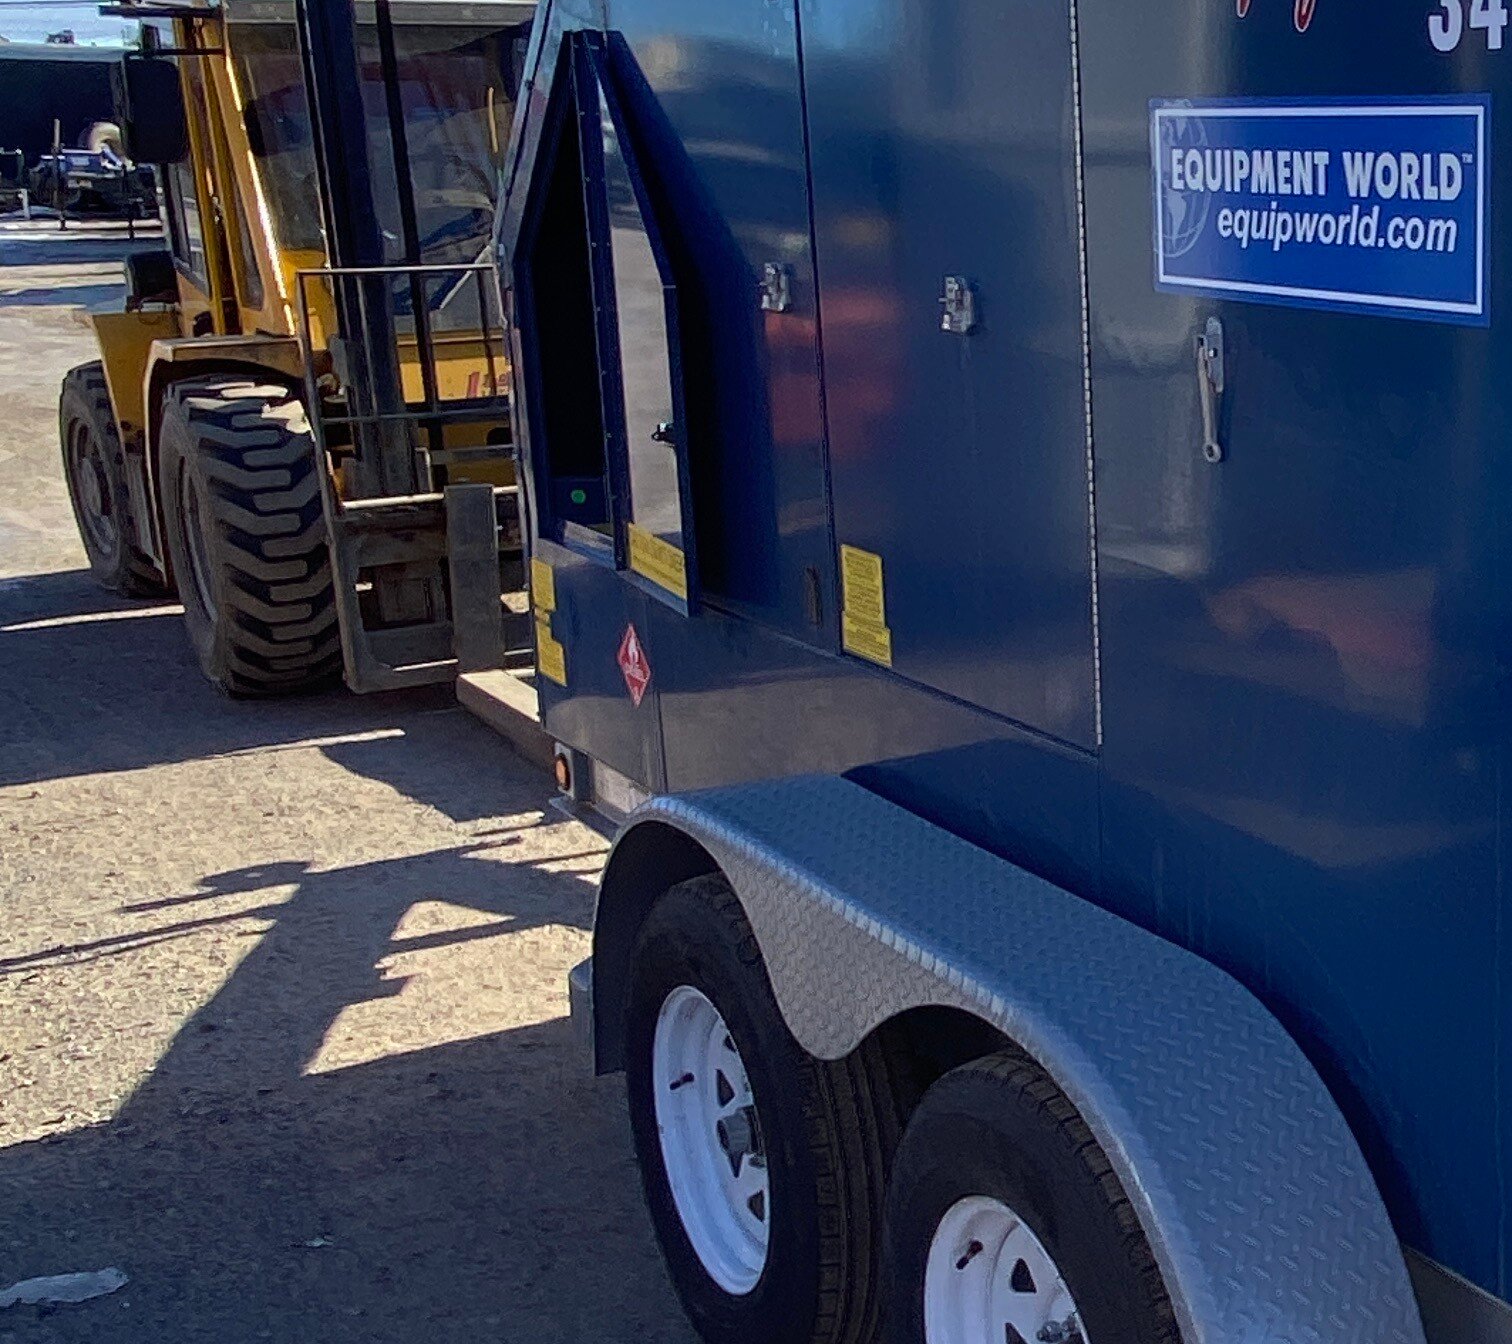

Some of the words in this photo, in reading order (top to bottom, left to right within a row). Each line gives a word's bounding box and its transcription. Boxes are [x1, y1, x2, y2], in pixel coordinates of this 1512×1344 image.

[1170, 148, 1330, 197] EQUIPMENT
[1342, 151, 1463, 202] WORLD
[1216, 201, 1458, 253] equipworld.com
